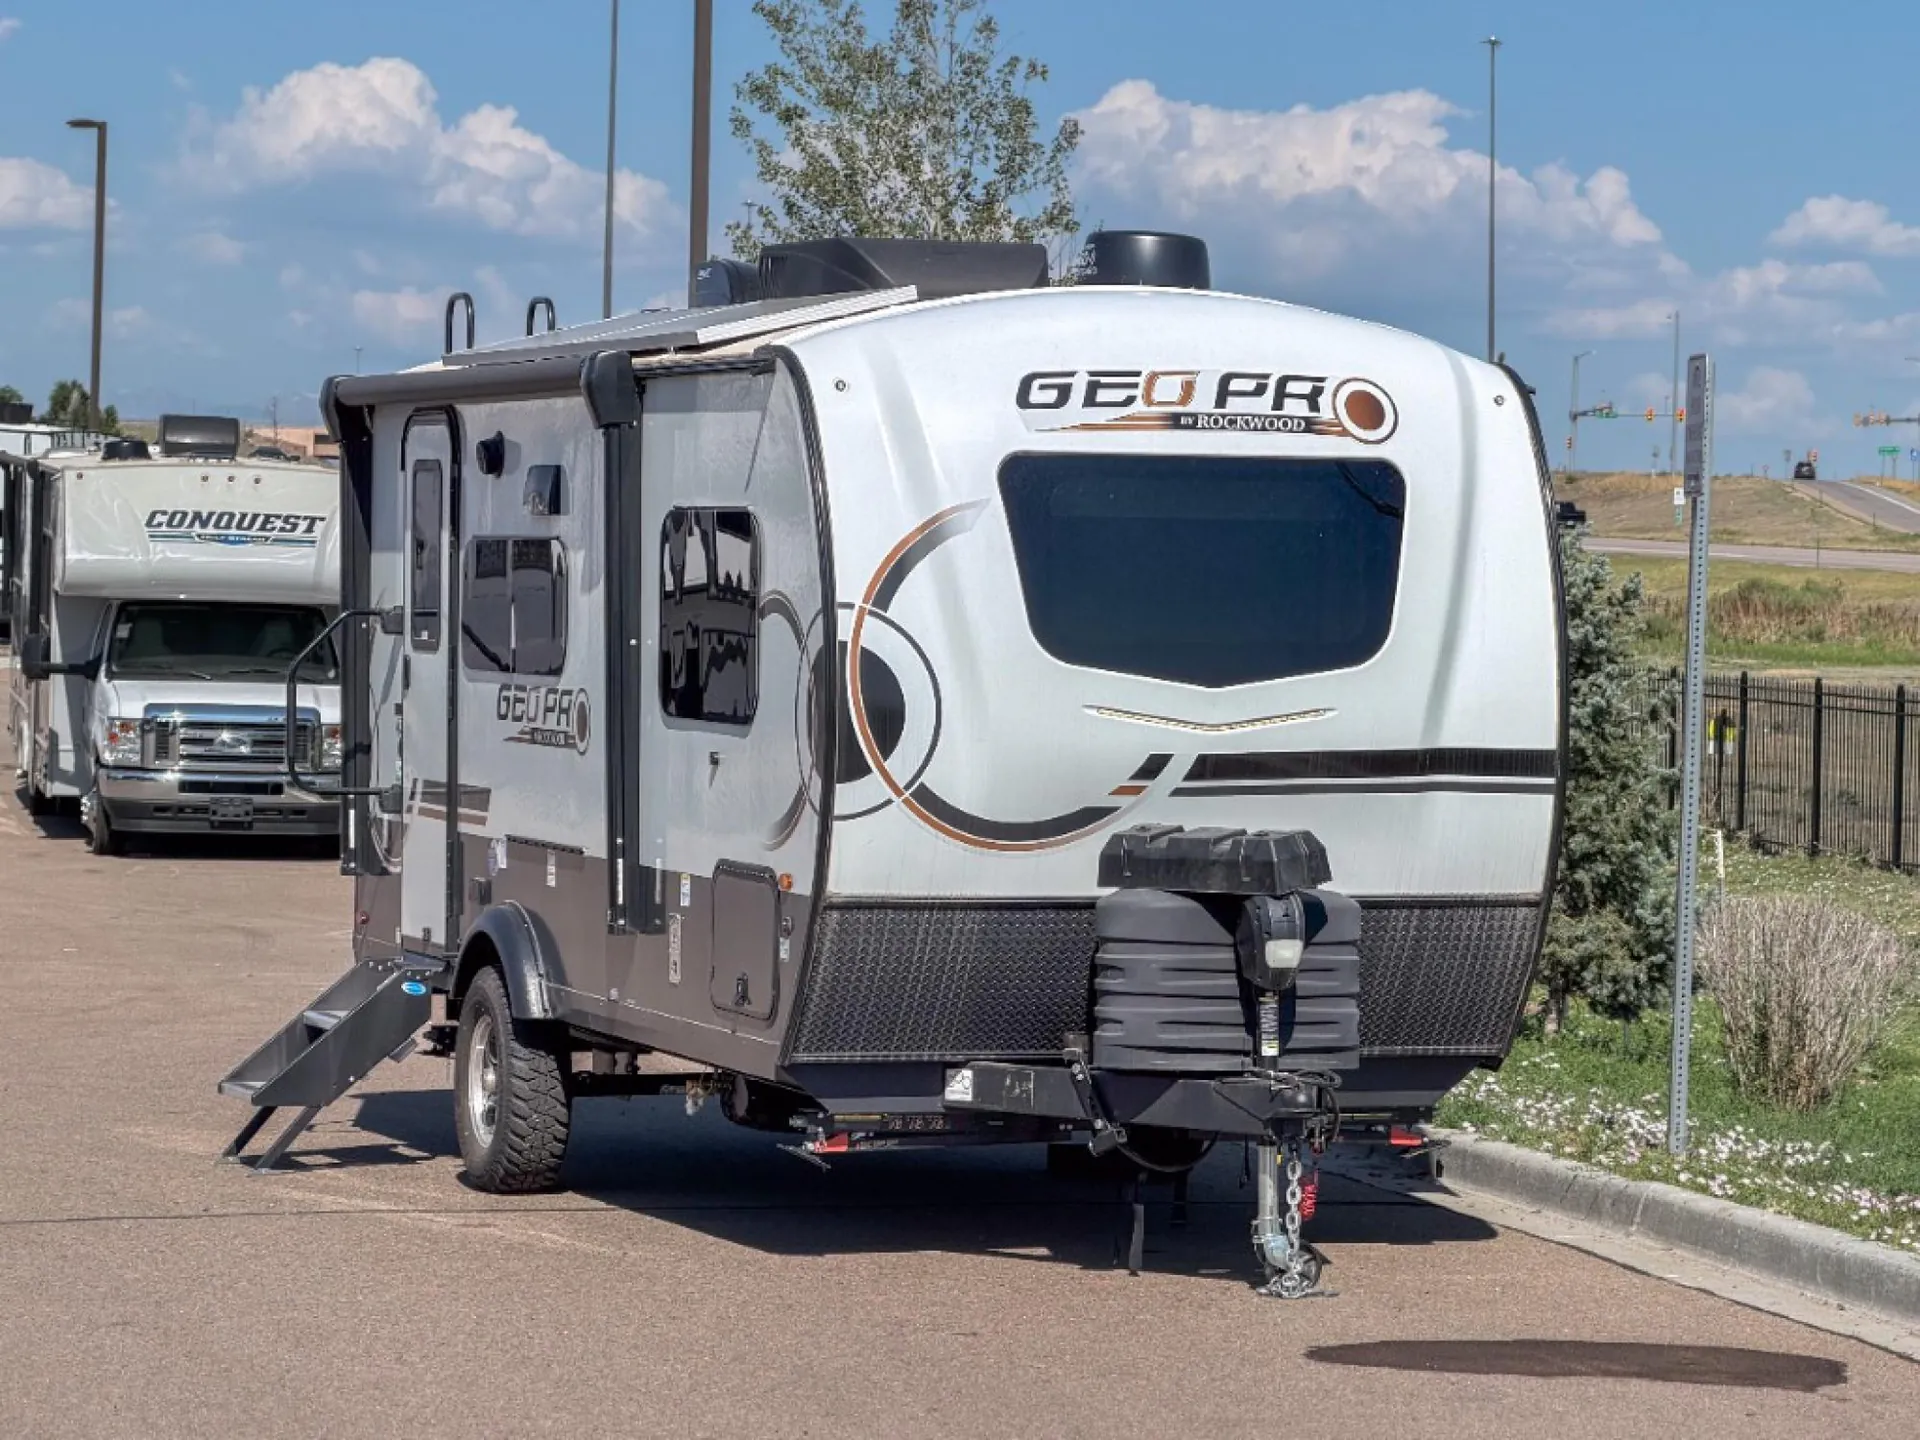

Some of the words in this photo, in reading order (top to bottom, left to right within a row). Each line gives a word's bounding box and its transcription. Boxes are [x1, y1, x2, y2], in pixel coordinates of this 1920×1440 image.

[1016, 370, 1200, 410] GEO
[1213, 371, 1399, 444] PRO
[1180, 415, 1194, 425] BY
[1196, 413, 1306, 432] ROCKWOOD
[145, 509, 327, 534] CONQUEST
[496, 683, 541, 723] GEO
